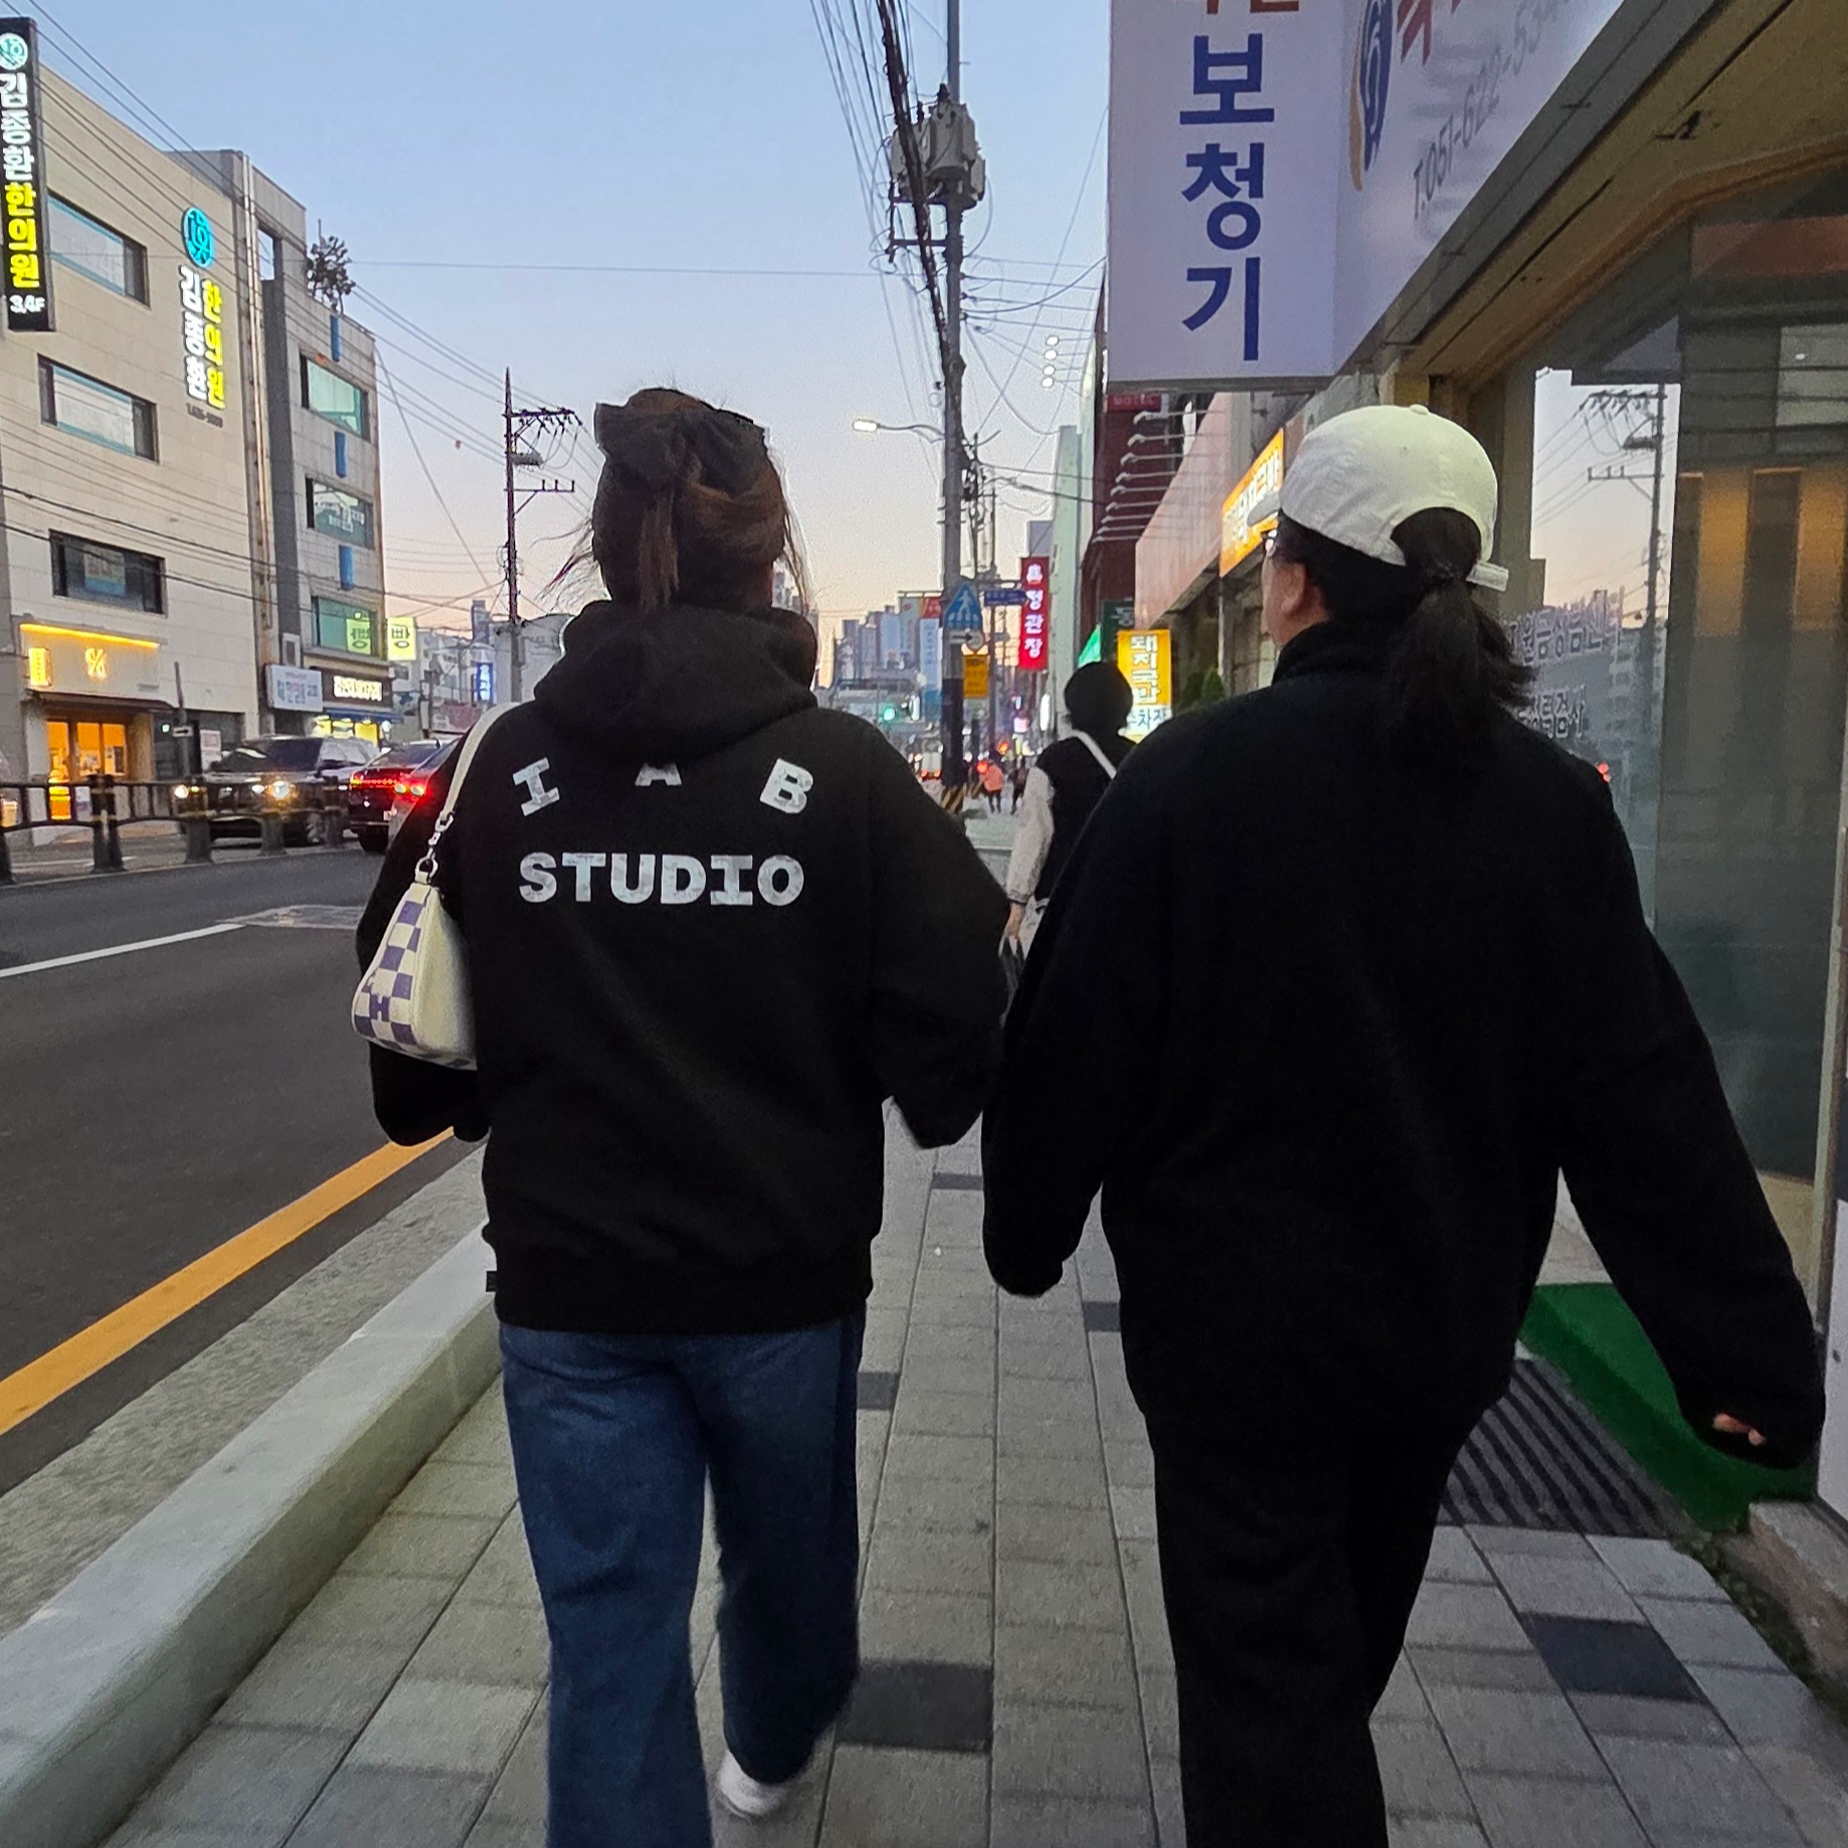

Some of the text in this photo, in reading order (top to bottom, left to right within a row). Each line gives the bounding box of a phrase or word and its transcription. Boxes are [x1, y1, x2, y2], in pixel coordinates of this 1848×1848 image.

[1180, 33, 1275, 361] 보청기
[203, 279, 226, 411] 한의원
[1130, 634, 1161, 705] 돼지국밥
[519, 852, 804, 907] STUDIO
